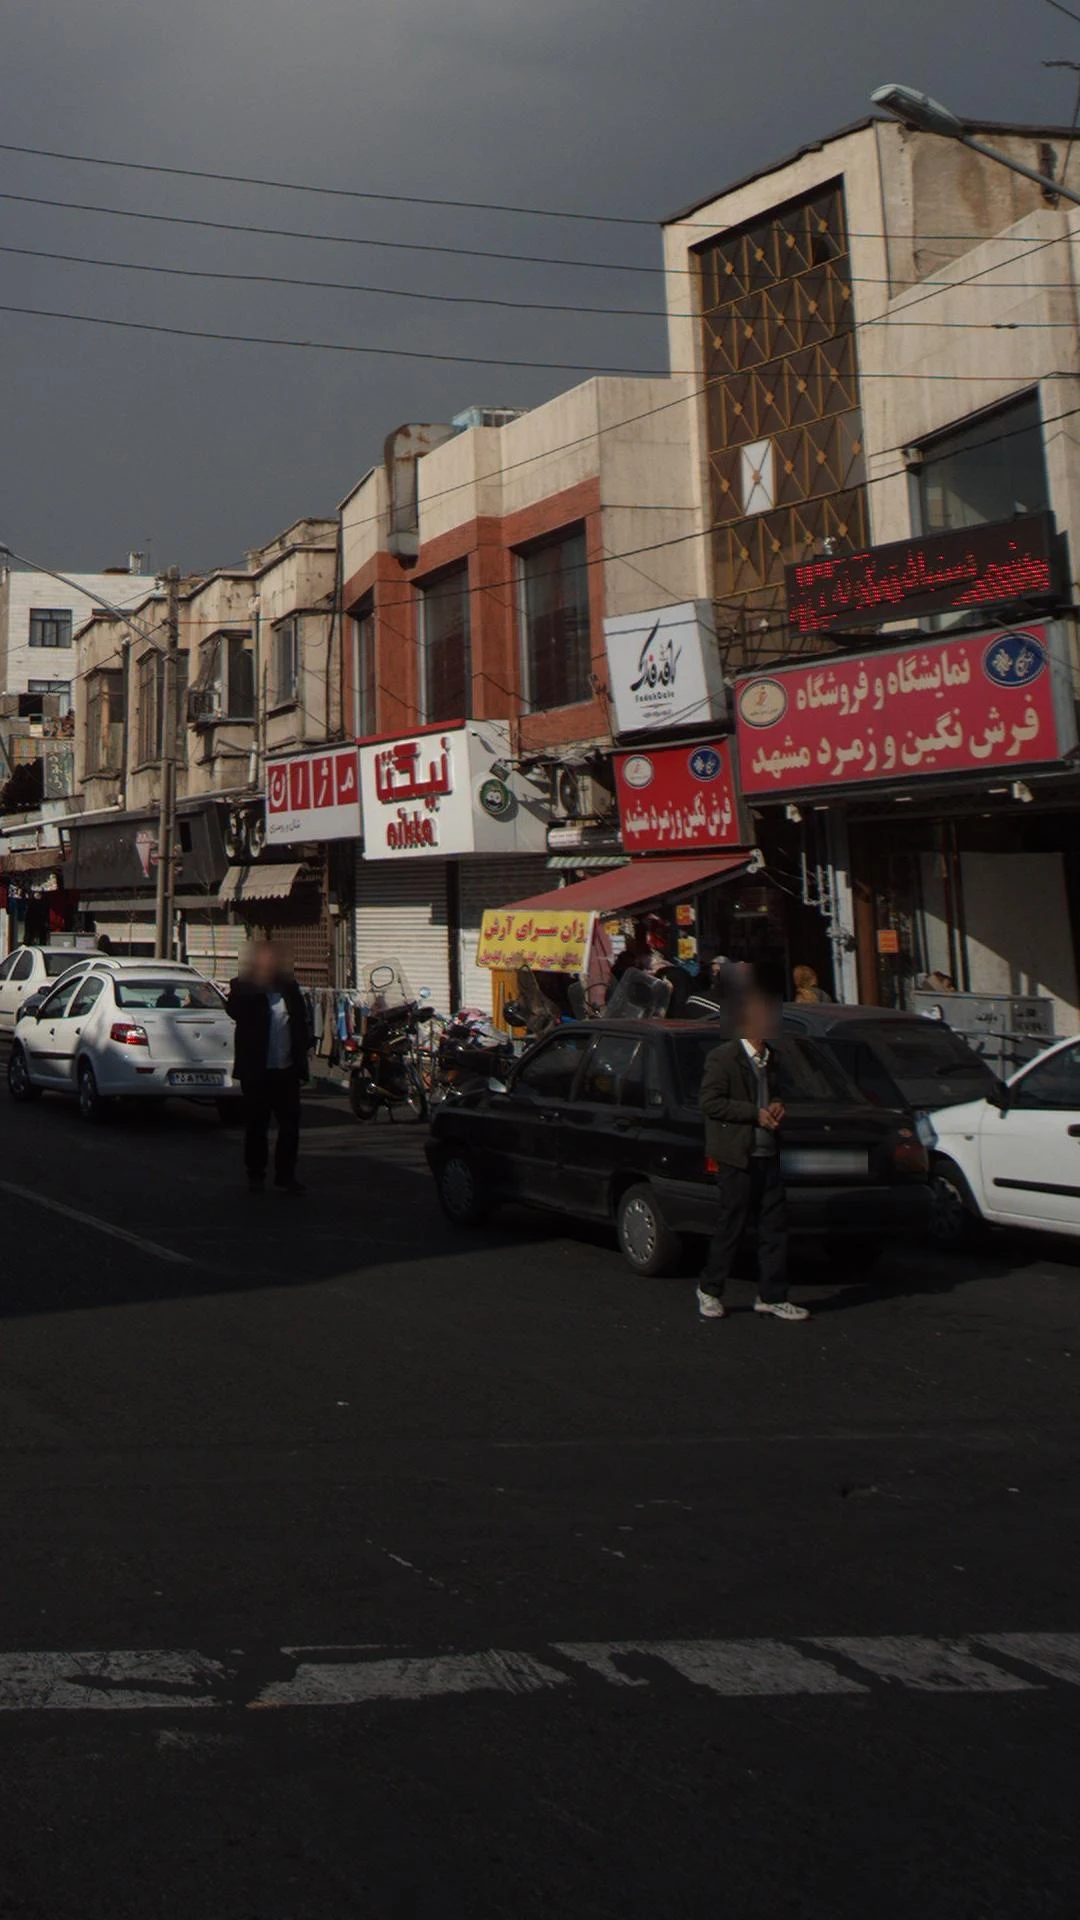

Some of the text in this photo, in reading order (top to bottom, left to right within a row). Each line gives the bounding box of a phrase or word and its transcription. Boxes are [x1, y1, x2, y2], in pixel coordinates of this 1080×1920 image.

[797, 661, 868, 715] فروشگاه
[873, 677, 885, 710] و
[887, 648, 971, 698] نمایشگاه
[901, 708, 963, 767] نگین
[969, 694, 1040, 758] فرش
[752, 734, 811, 779] مشهد
[817, 727, 877, 776] زمرد
[881, 732, 897, 769] و
[625, 798, 650, 840] مشهد
[650, 801, 676, 840] زمرد
[683, 789, 706, 838] نگین
[707, 786, 733, 837] فرش
[485, 916, 515, 941] آرش
[516, 919, 558, 942] سرای
